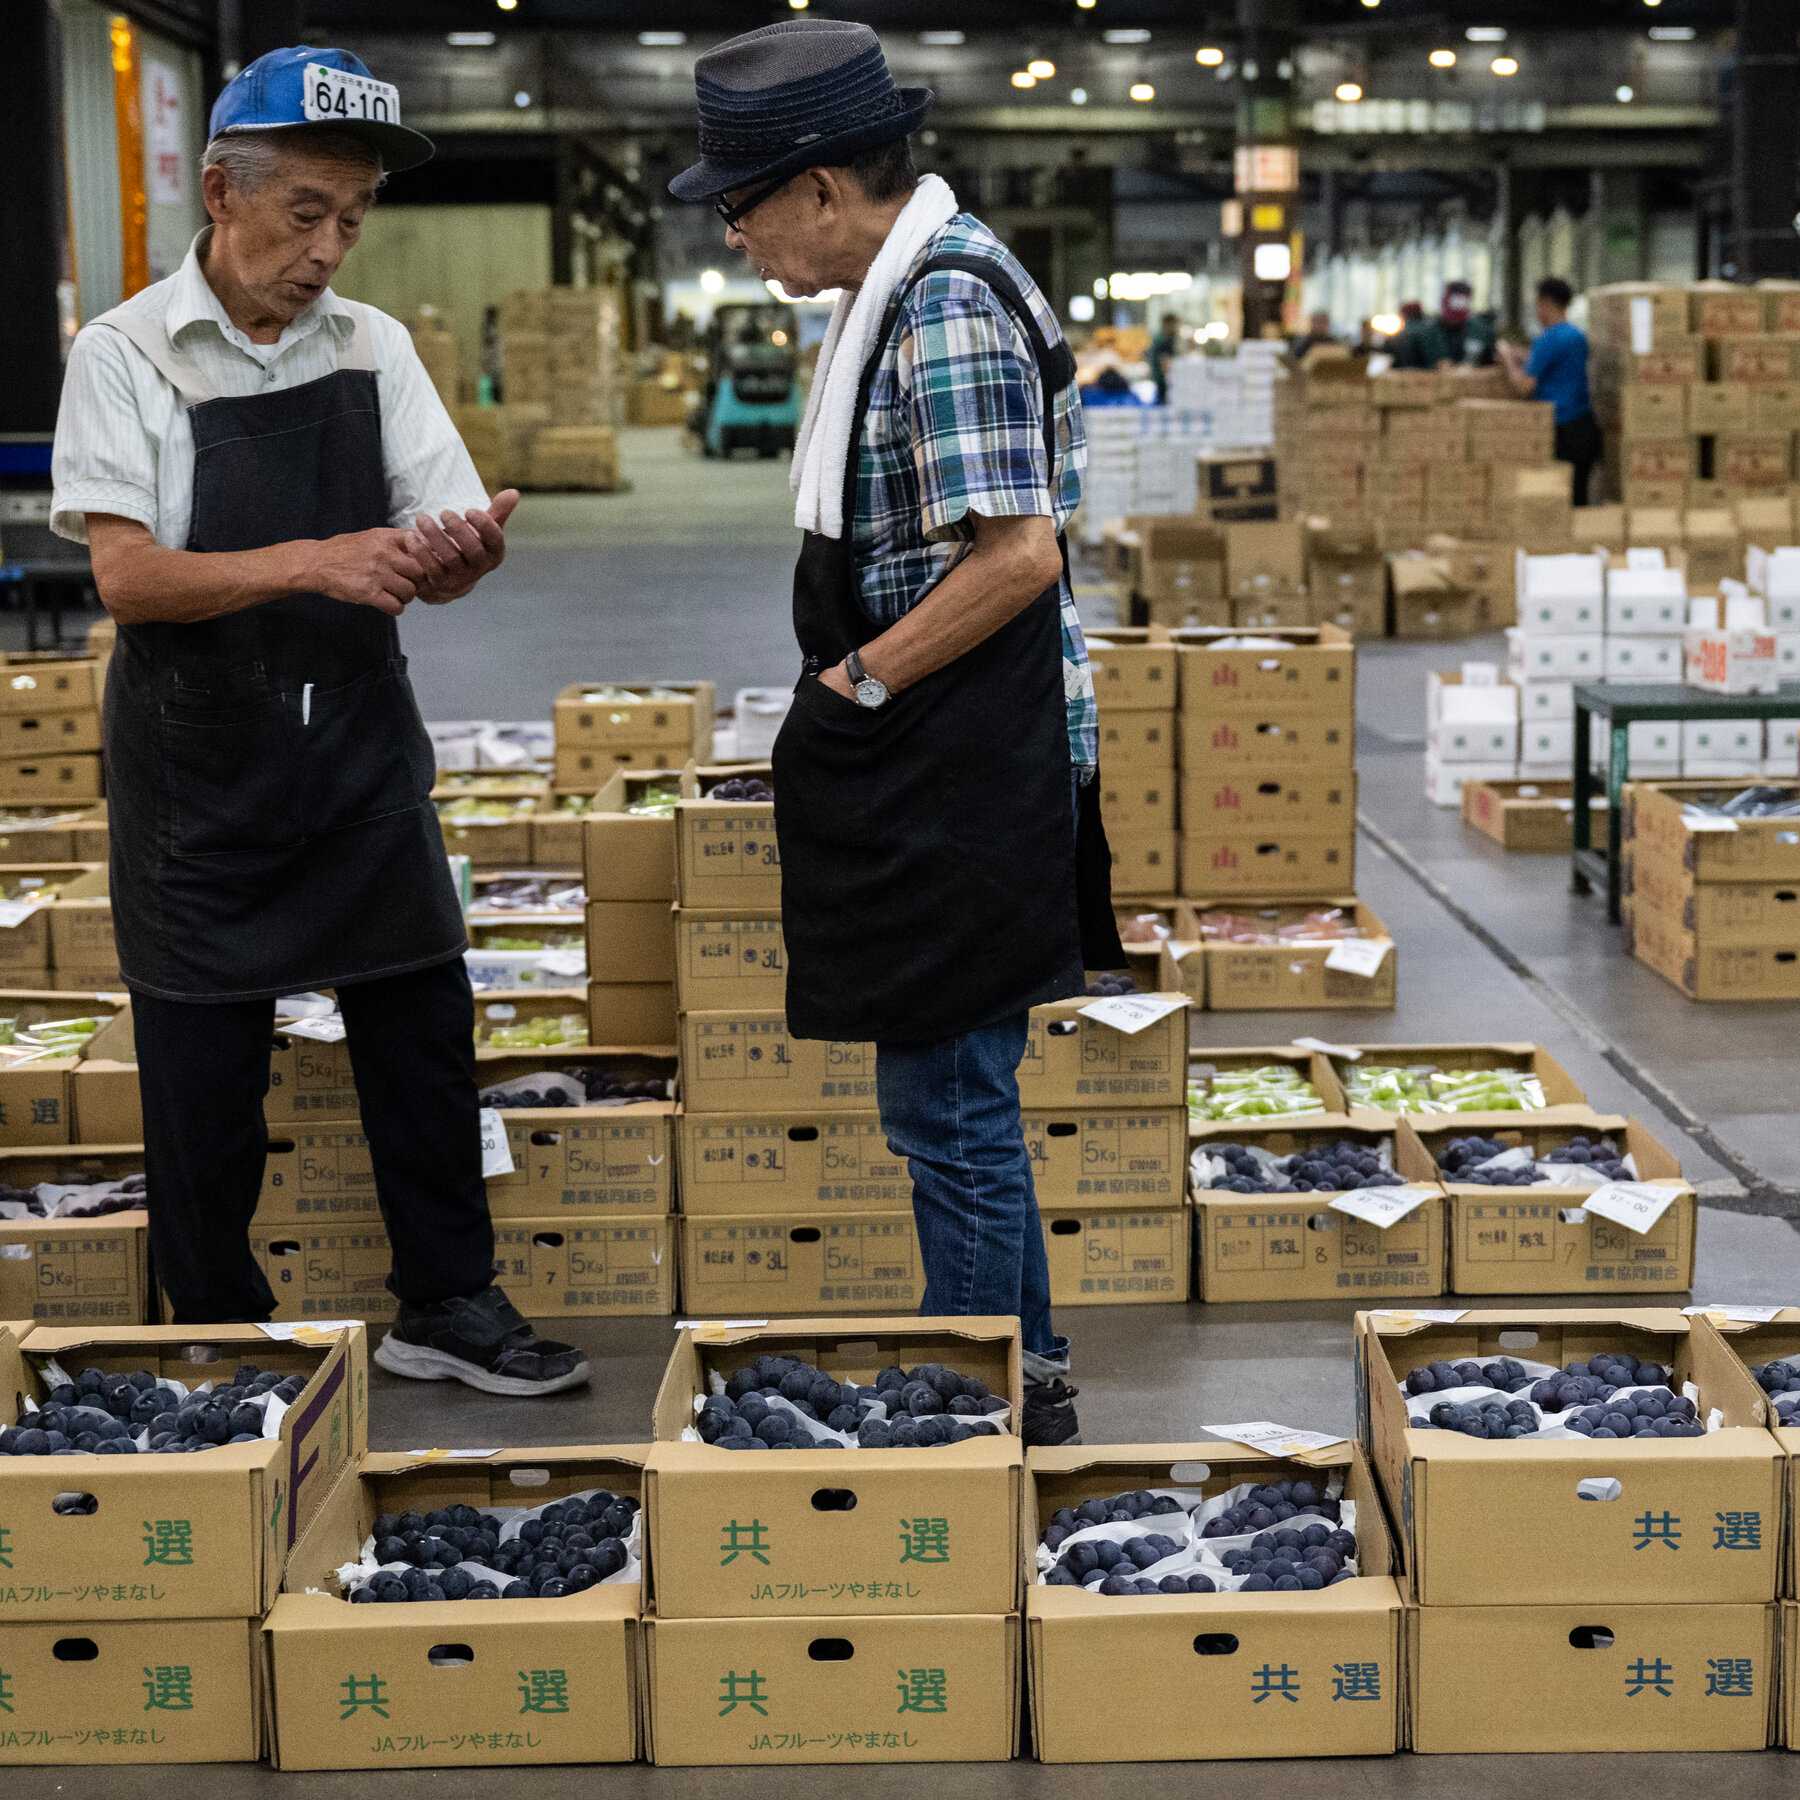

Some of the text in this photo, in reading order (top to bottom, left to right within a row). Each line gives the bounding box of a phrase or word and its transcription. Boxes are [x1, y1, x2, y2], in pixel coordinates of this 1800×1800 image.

[762, 844, 781, 865] 3L
[762, 949, 783, 969] 3L
[774, 1044, 792, 1064] 3L
[272, 1072, 282, 1086] 8
[763, 1149, 783, 1169] 3L
[272, 1173, 283, 1186] 8
[539, 1165, 549, 1178] 7
[766, 1250, 788, 1270] 3L
[1315, 1247, 1328, 1263] 8
[281, 1269, 292, 1283] 8
[546, 1272, 556, 1284] 7
[143, 1520, 193, 1566] 選
[721, 1518, 950, 1566] 共 選
[751, 1581, 921, 1600] JAフルーツやまなし
[143, 1666, 193, 1710] 選
[340, 1669, 570, 1720] 共 選
[718, 1668, 948, 1717] 共 選
[371, 1732, 541, 1752] JAフルーツやまなし
[748, 1731, 918, 1750] JAフルーツやまなし
